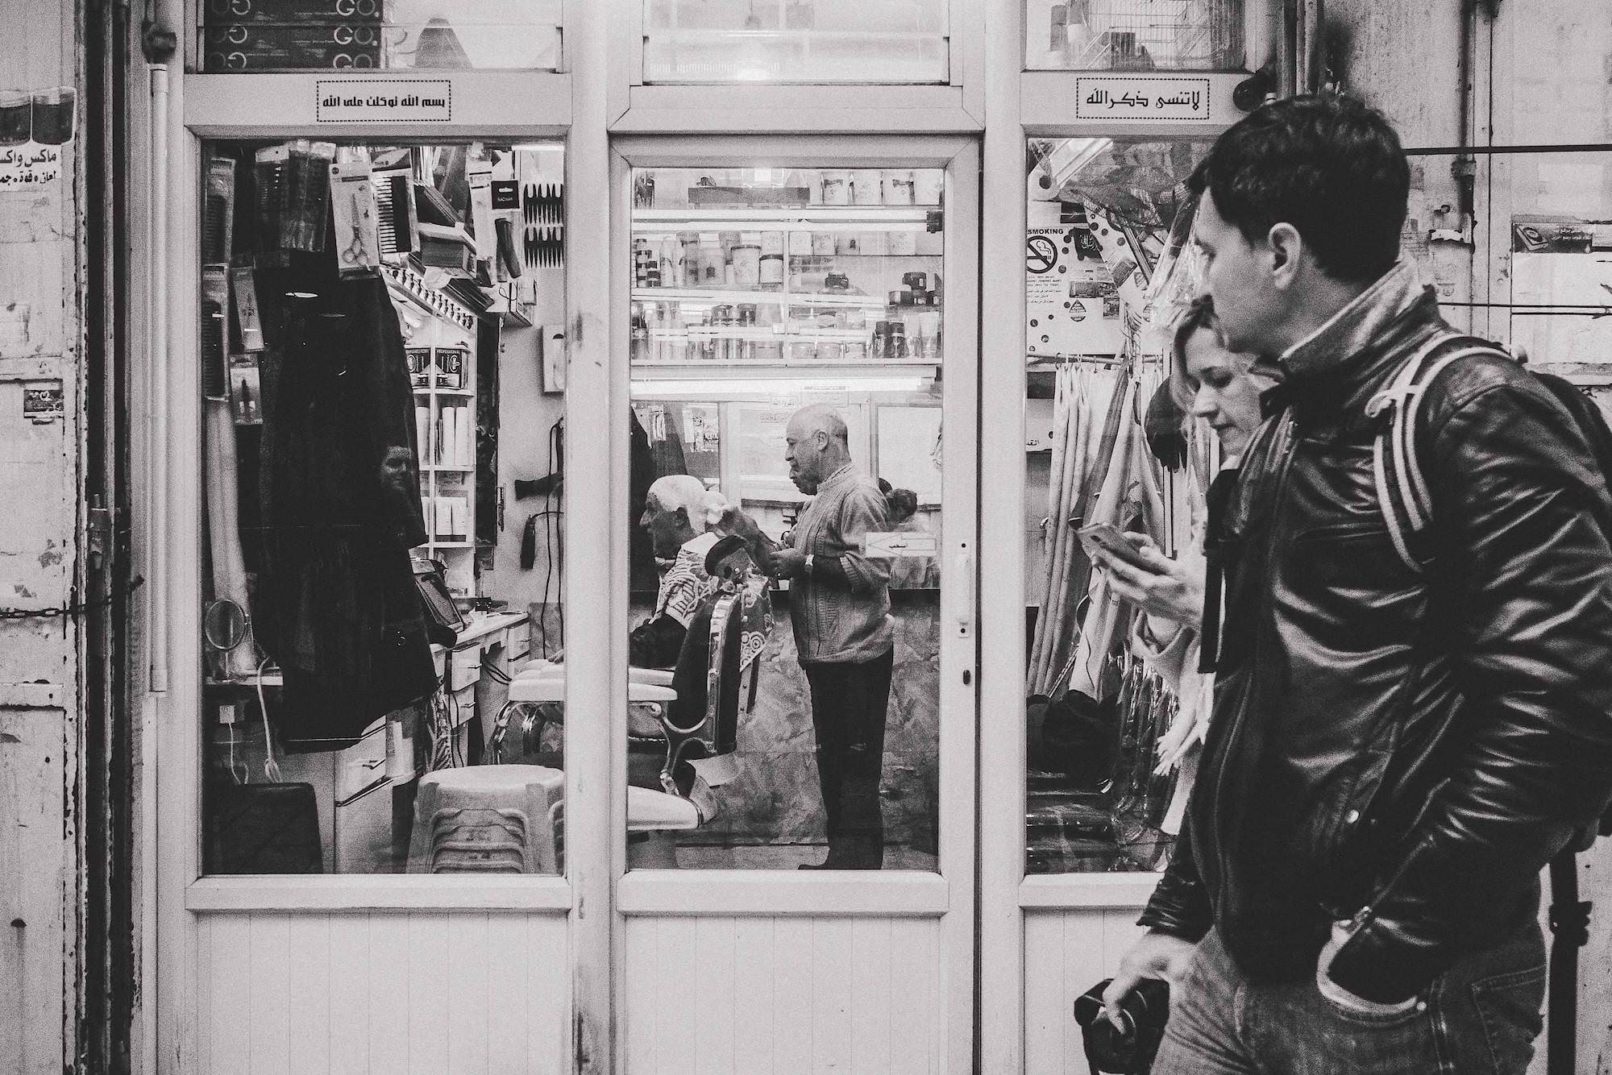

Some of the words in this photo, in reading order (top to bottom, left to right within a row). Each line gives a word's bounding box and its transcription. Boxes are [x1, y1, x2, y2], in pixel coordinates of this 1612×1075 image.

[322, 94, 340, 107] الله
[343, 96, 363, 107] على
[401, 94, 419, 107] الله
[422, 97, 445, 108] بسم
